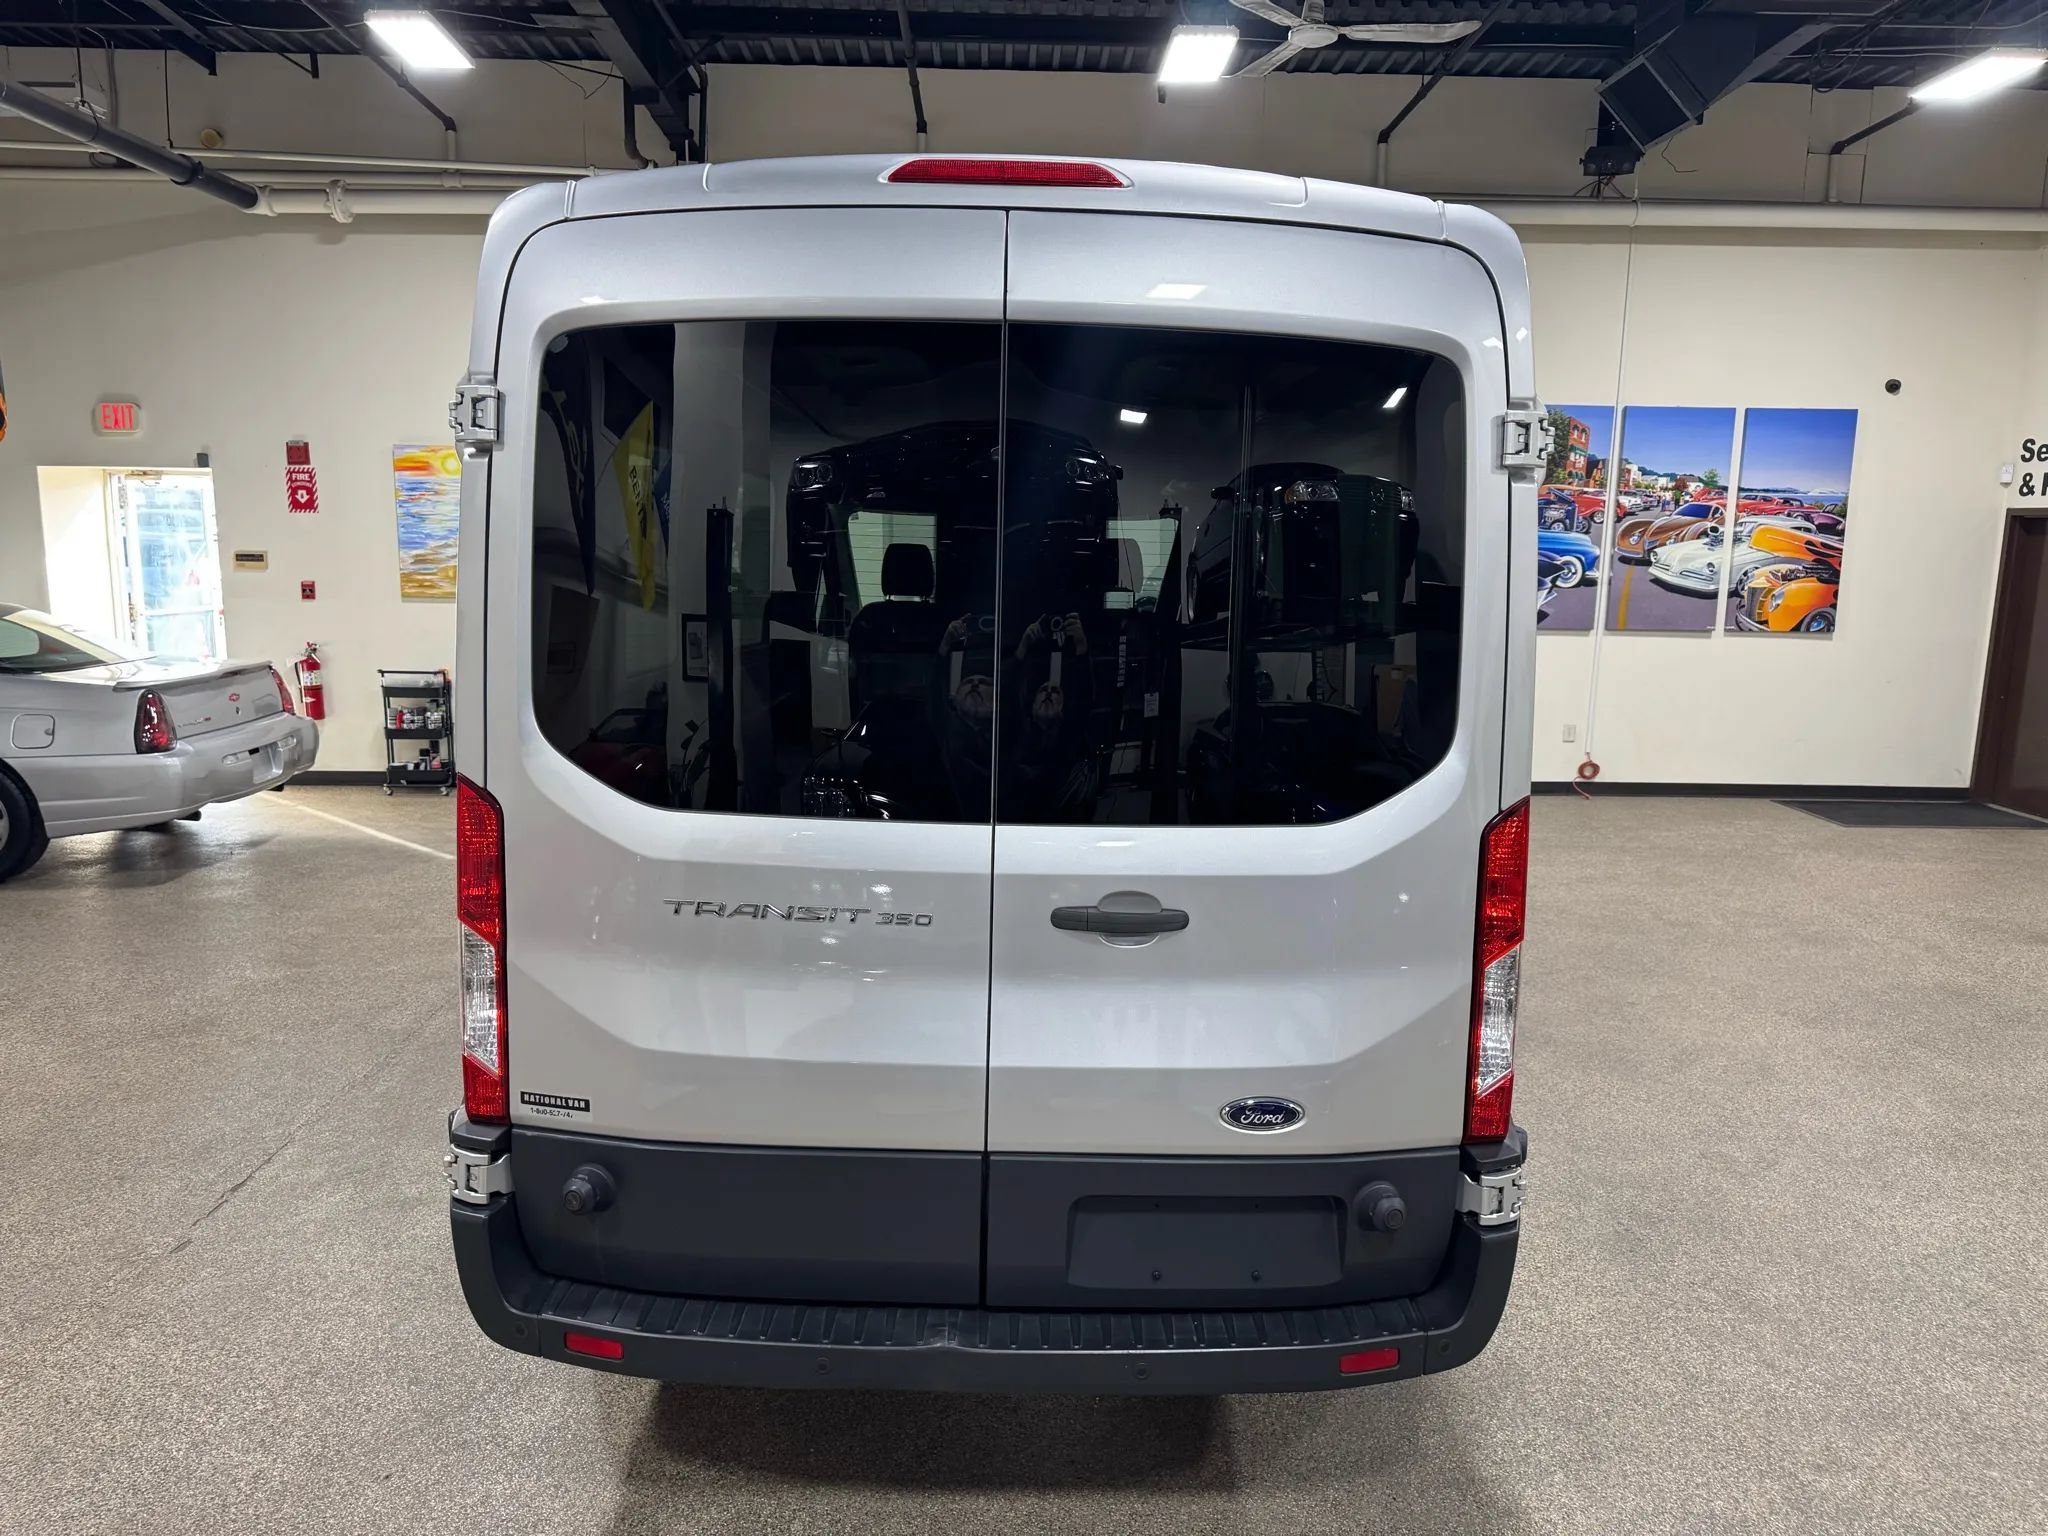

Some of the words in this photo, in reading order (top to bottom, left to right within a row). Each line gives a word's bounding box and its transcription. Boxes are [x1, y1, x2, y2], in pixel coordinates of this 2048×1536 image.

[100, 404, 135, 430] EXIT
[2020, 438, 2048, 463] Se
[291, 473, 311, 481] FIRE
[2018, 472, 2035, 496] &
[663, 898, 872, 924] TRANSIT
[875, 911, 933, 926] 350
[523, 1093, 567, 1106] NATIONAL
[567, 1099, 586, 1109] VAN
[1241, 1107, 1286, 1124] Ford
